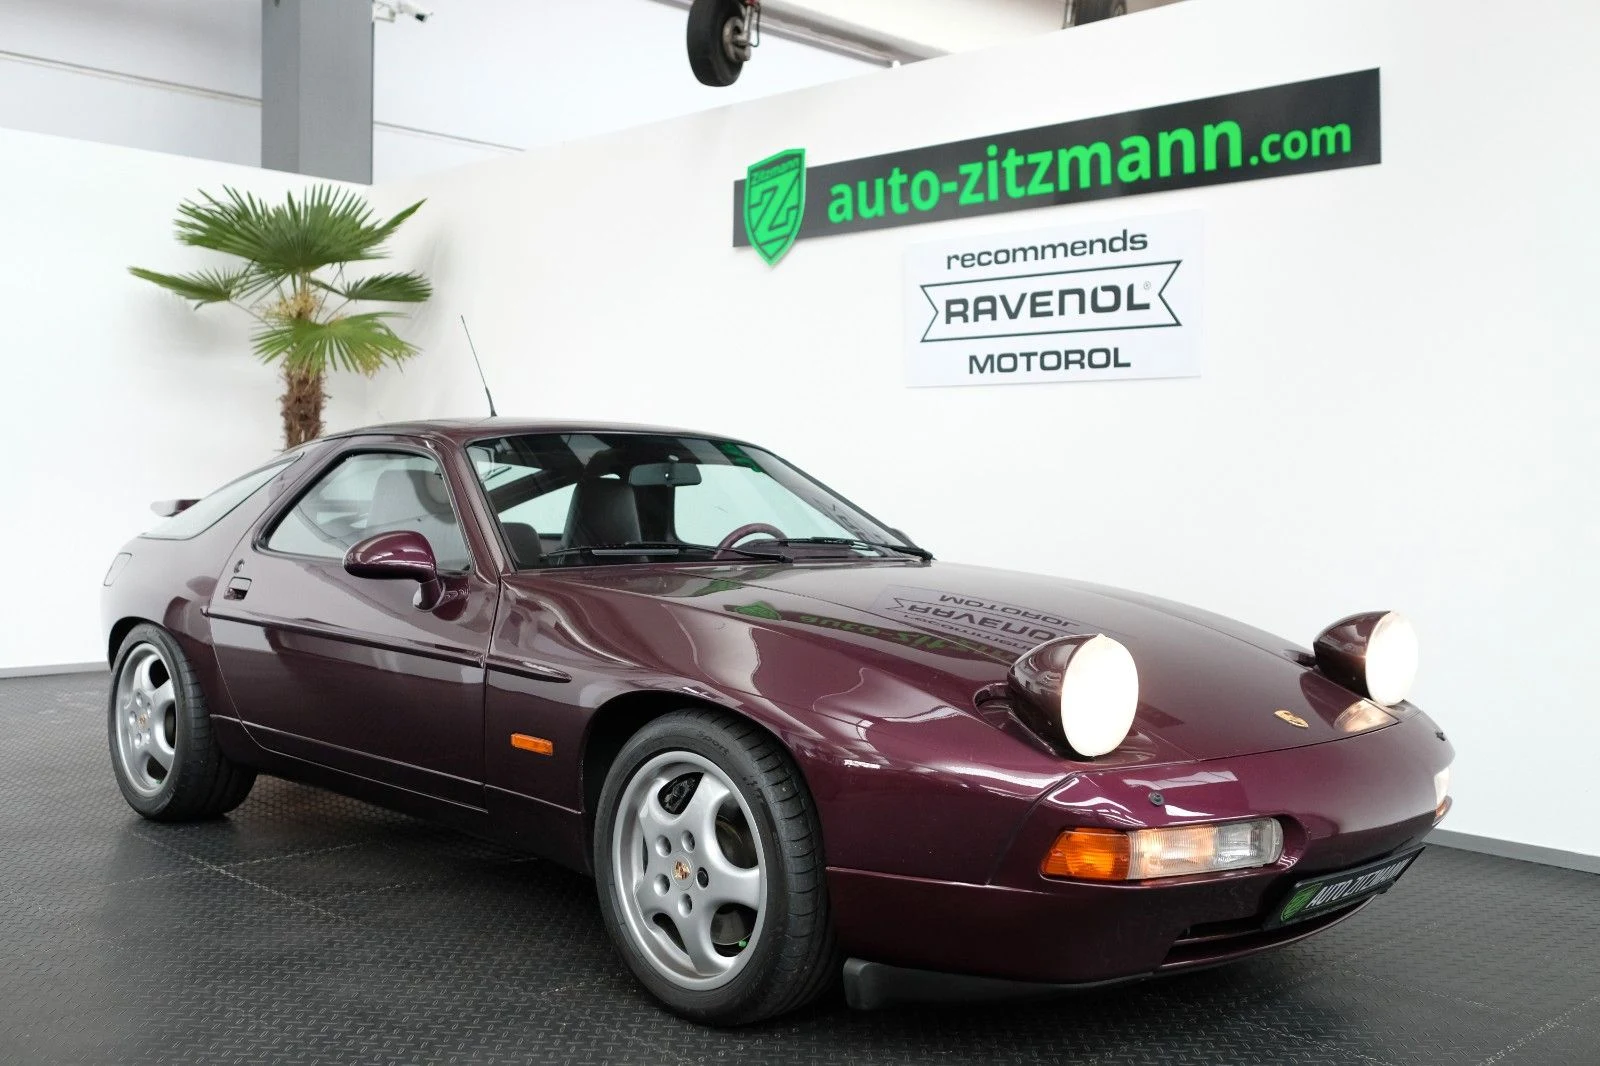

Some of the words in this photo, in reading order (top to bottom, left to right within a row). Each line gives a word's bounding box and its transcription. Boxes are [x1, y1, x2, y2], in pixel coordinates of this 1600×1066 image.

[946, 229, 1149, 270] recommends
[944, 283, 1151, 325] RAVENOL
[968, 347, 1132, 375] MOTOROL
[1305, 879, 1354, 909] AUTO
